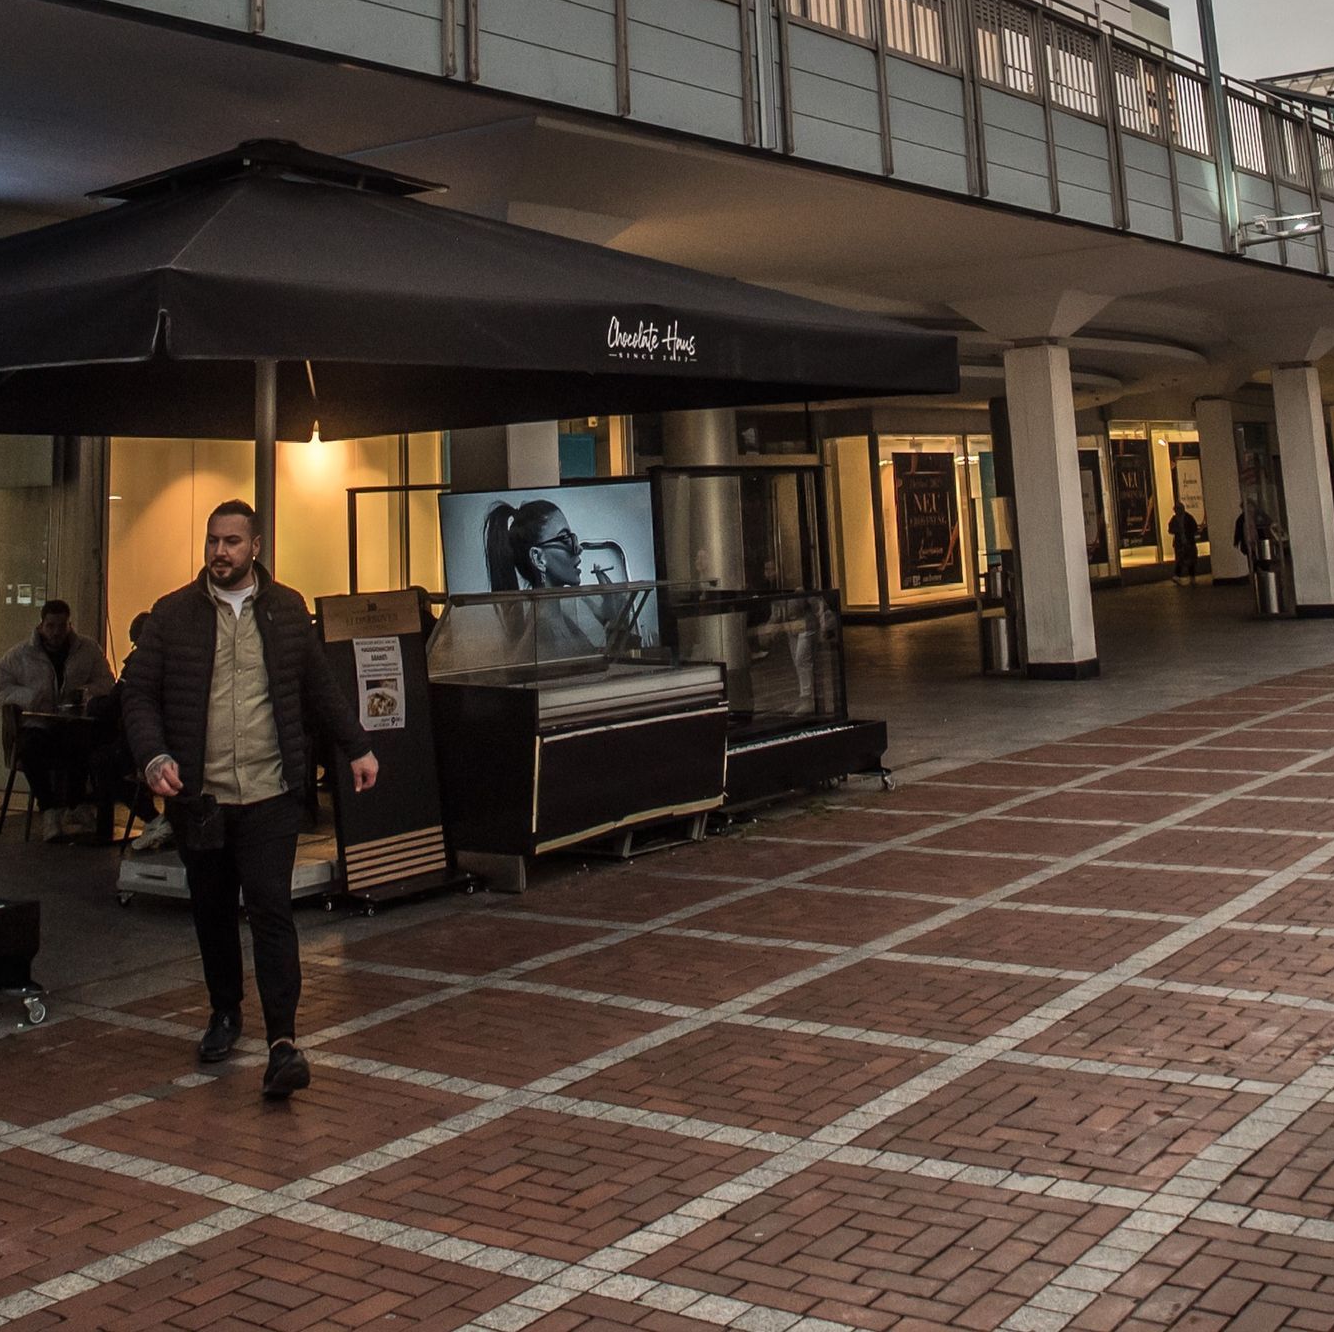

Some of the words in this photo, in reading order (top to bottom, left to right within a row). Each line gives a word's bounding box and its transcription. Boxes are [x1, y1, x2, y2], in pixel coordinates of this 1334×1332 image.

[607, 315, 660, 354] Chocolate
[661, 319, 696, 361] Haus
[913, 492, 941, 514] NEU
